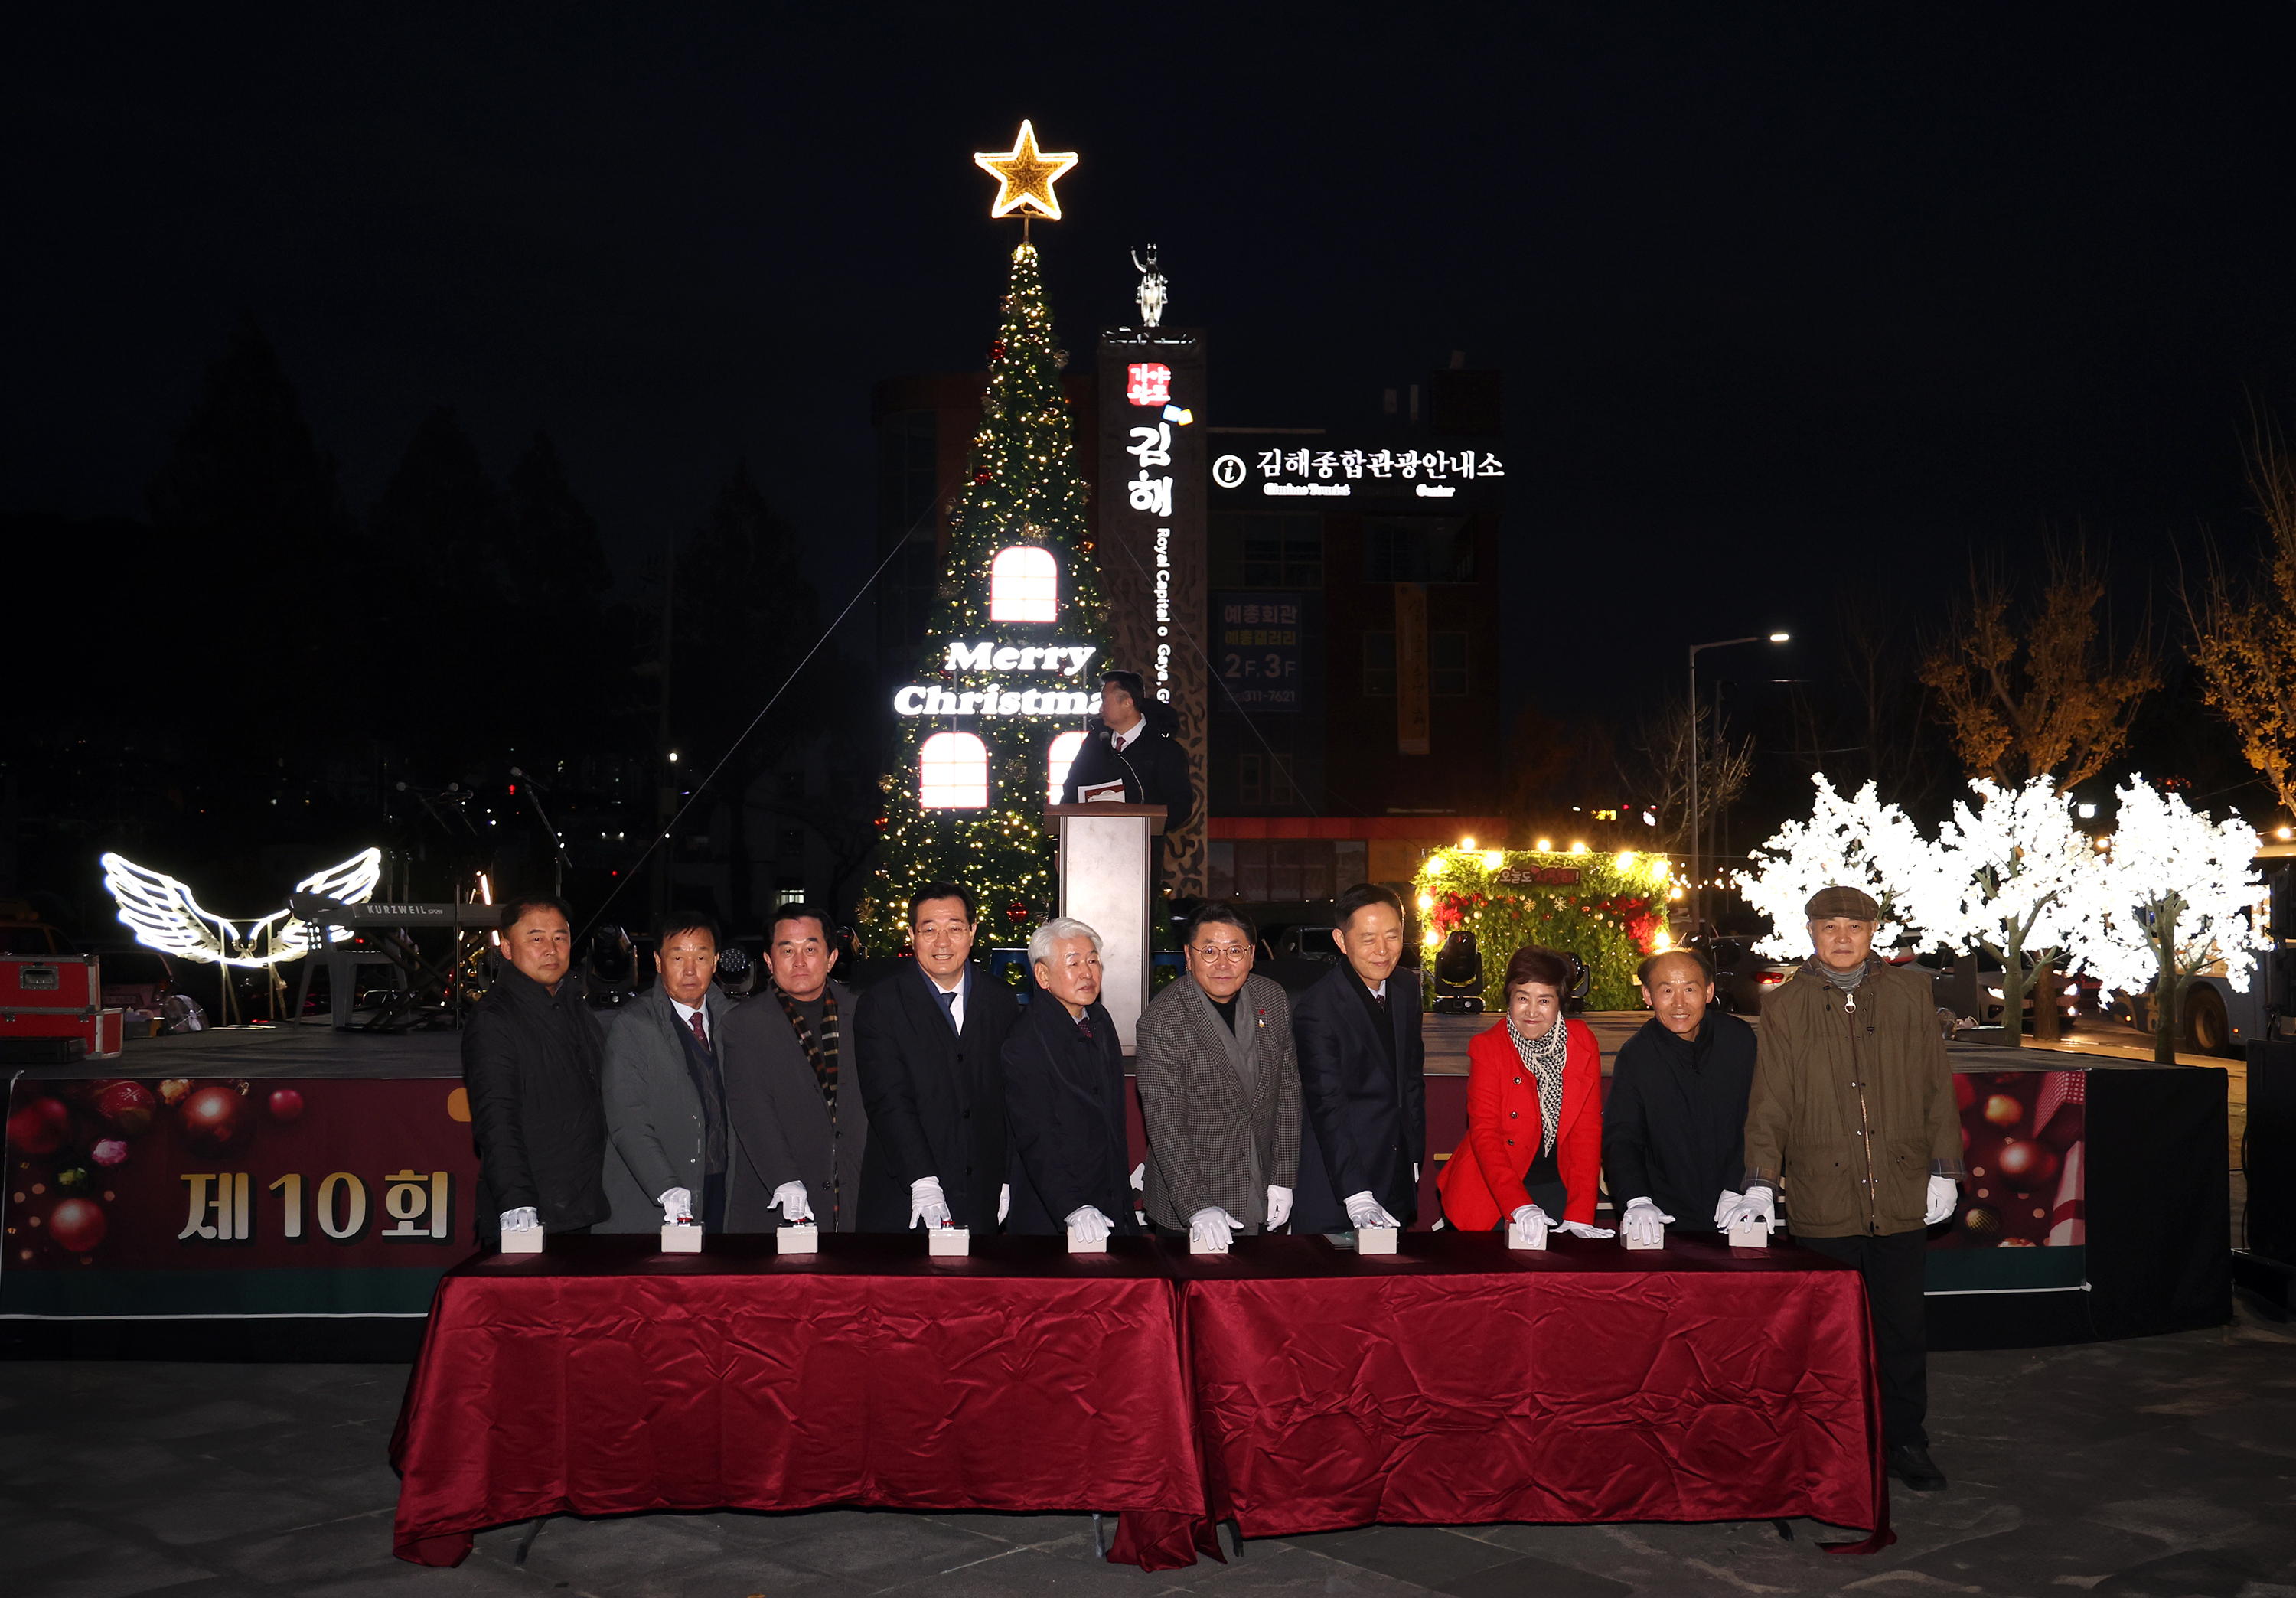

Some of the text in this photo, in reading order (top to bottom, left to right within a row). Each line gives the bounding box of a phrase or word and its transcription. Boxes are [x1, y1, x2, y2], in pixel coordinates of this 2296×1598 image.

[1130, 363, 1171, 384] 가야
[1127, 383, 1171, 405] 왕도
[1126, 422, 1173, 517] 김해
[1256, 448, 1505, 479] 김해종합관광안내소
[1263, 482, 1309, 496] Gimhae
[1309, 483, 1351, 496] Tourist
[1415, 483, 1456, 497] Center
[1153, 528, 1170, 567] Royal
[1153, 570, 1170, 622] Capital
[1225, 604, 1298, 624] 예총회관
[1225, 630, 1296, 646] 예총갤러리
[944, 642, 1096, 676] Merry
[1154, 644, 1171, 686] Gaya,
[1265, 653, 1296, 678] 3F
[893, 683, 1102, 716] Christma
[1500, 869, 1532, 884] 오늘도
[367, 905, 427, 915] KURZWEIL
